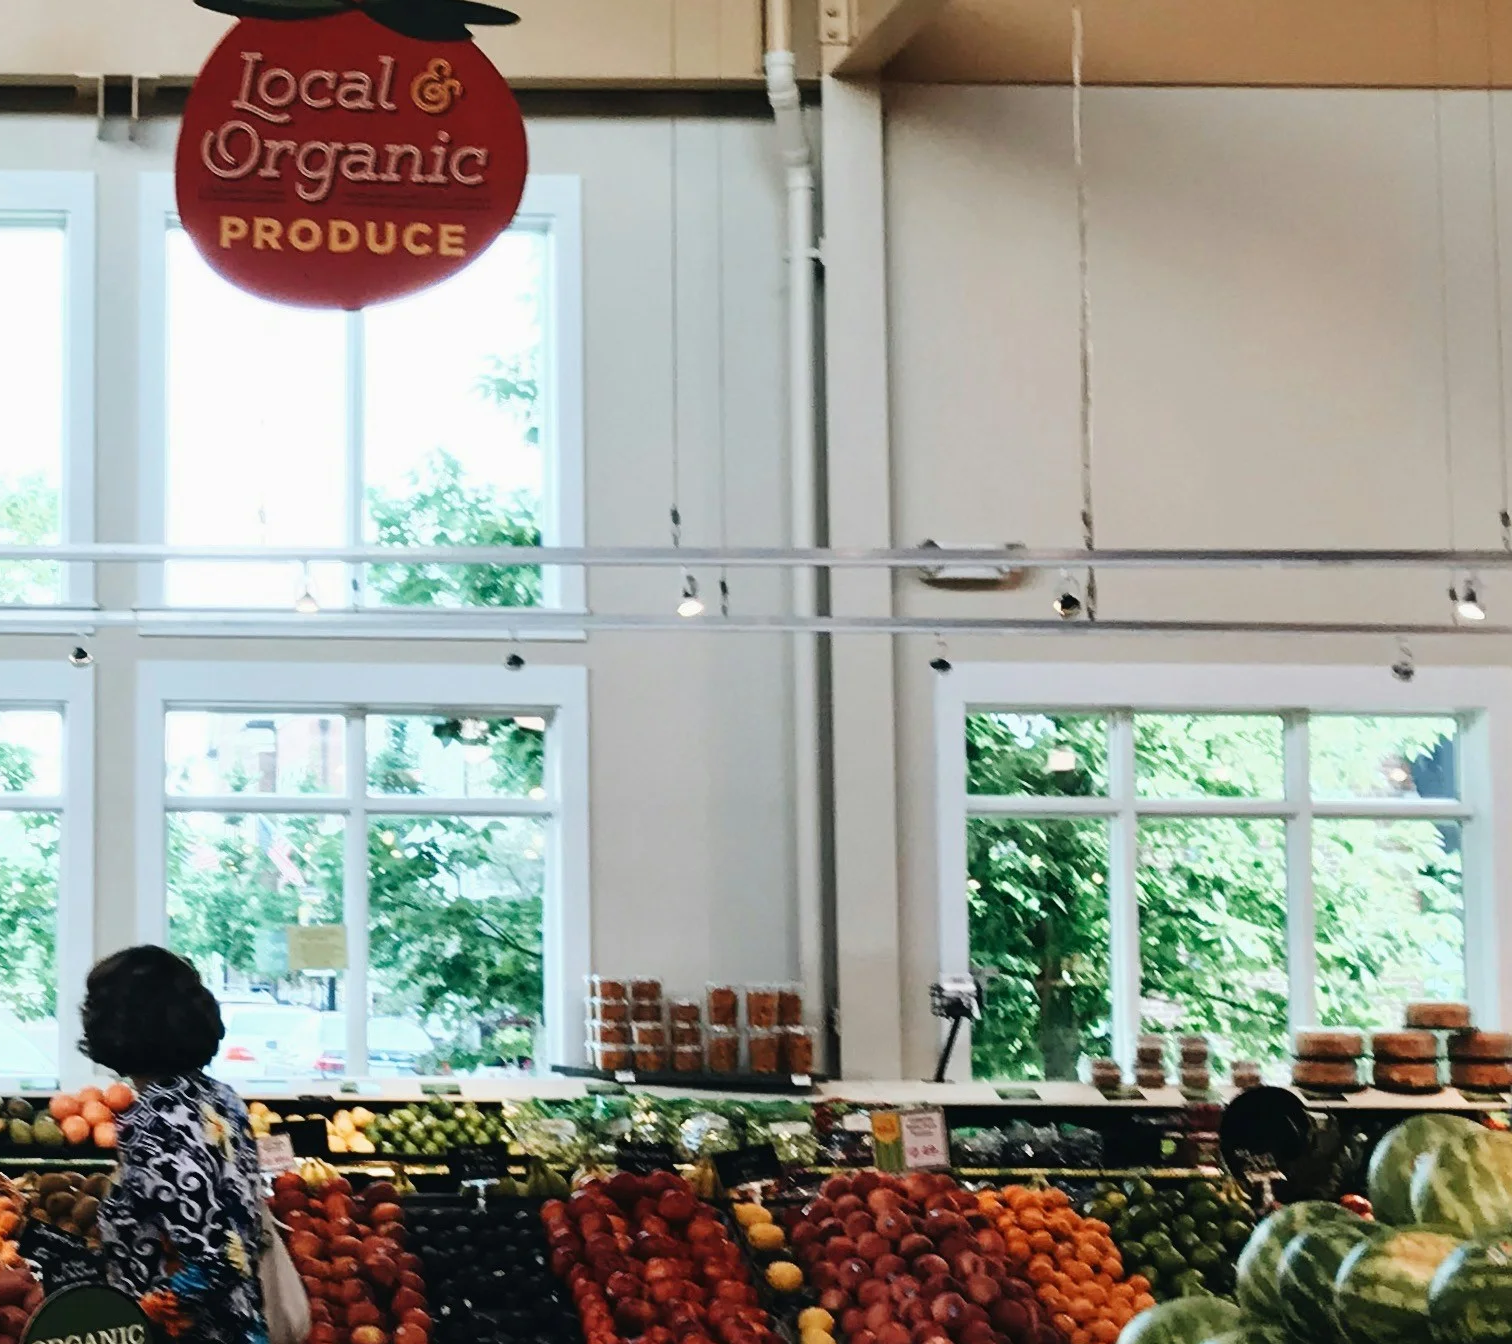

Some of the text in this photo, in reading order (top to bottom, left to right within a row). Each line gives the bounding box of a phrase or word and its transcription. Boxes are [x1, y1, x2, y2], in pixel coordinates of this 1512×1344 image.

[230, 50, 465, 124] Local &
[199, 119, 489, 203] Organic
[218, 214, 467, 257] PRODUCE
